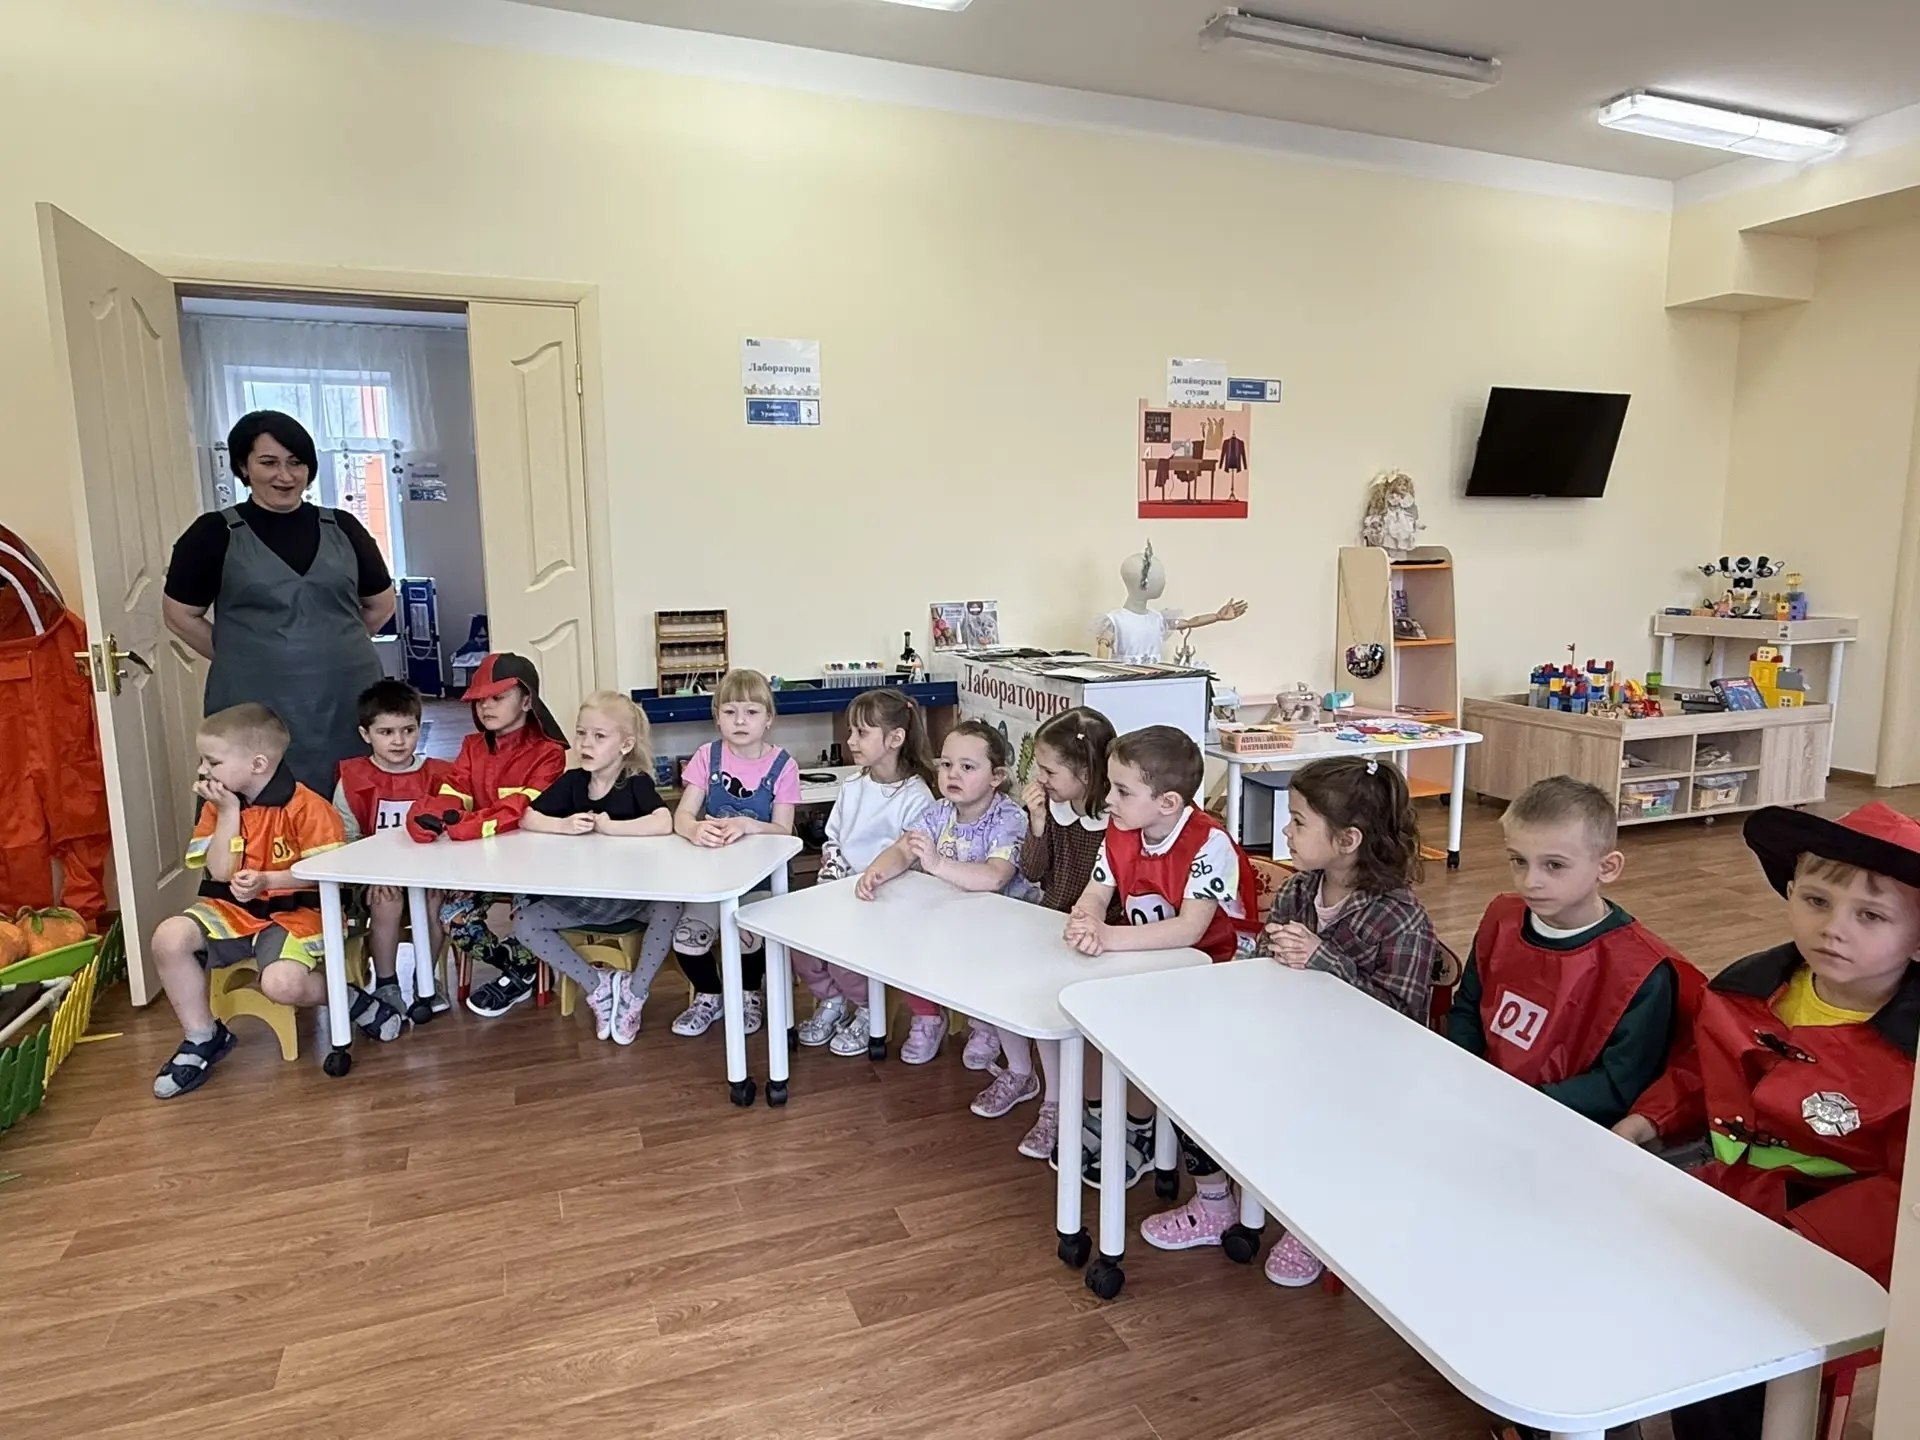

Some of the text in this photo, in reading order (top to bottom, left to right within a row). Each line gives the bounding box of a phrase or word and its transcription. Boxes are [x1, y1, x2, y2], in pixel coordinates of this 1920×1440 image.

[748, 362, 811, 375] Лаборатория
[961, 663, 1071, 722] Лаборатория
[377, 811, 403, 829] 11
[1131, 904, 1165, 926] 01
[1498, 1001, 1538, 1042] 01
